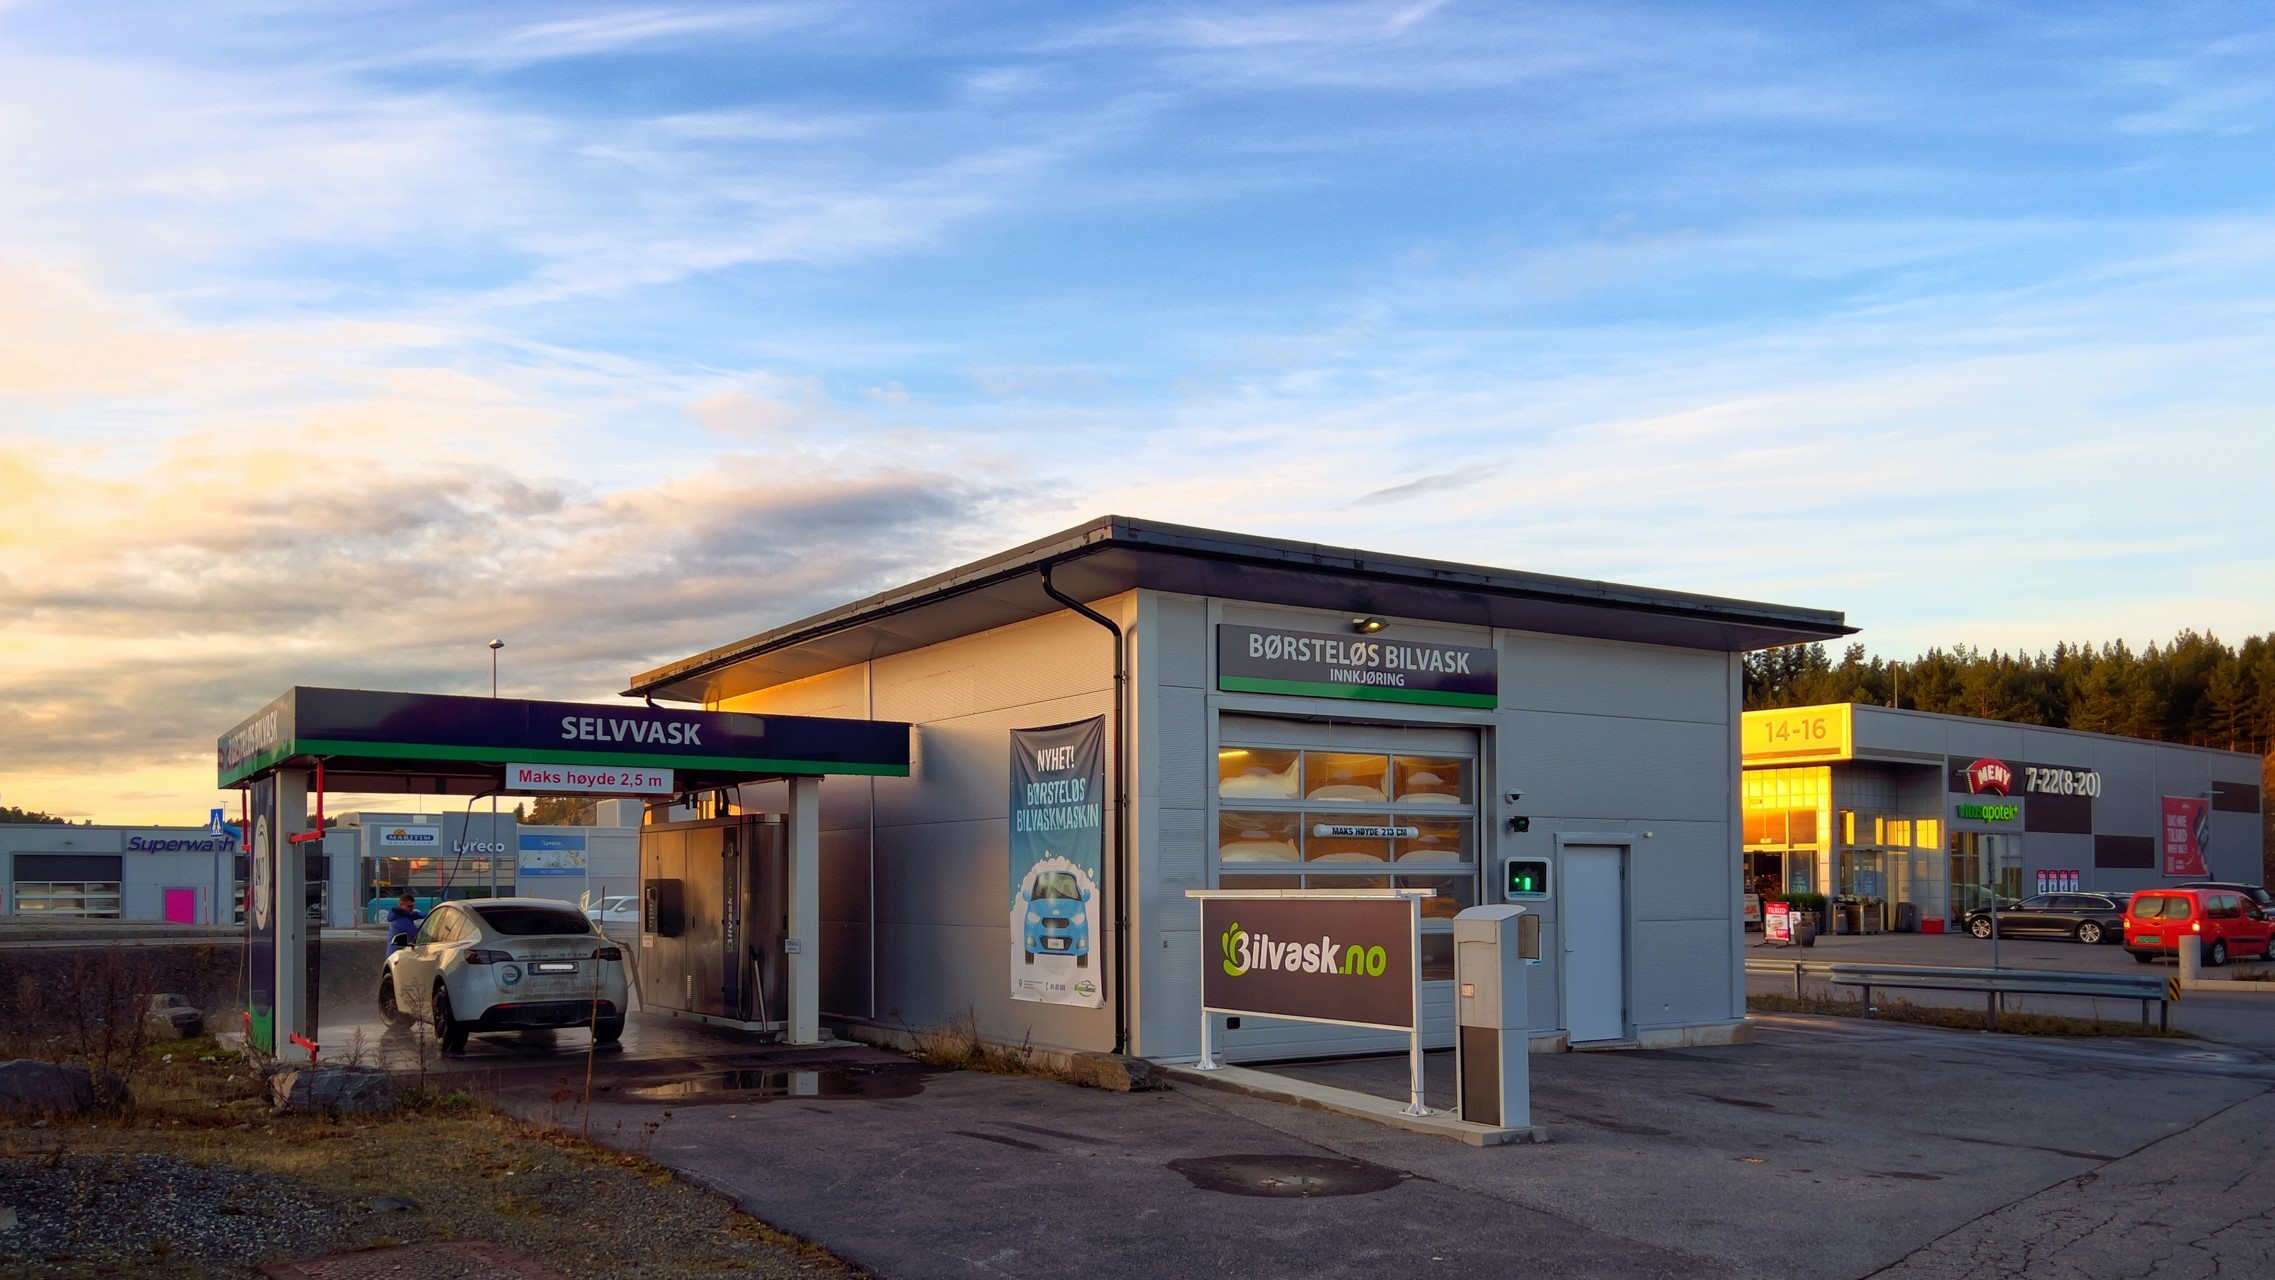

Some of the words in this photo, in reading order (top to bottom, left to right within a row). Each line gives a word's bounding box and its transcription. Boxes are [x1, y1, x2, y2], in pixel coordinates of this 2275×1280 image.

[1250, 633, 1379, 667] BØRSTELØS
[1385, 645, 1470, 675] BILVASK
[1330, 668, 1405, 687] INNKJØRING
[561, 716, 701, 745] SELVVASK
[1765, 717, 1827, 742] 14-16
[1037, 745, 1075, 772] NYHET!
[519, 769, 561, 784] Maks
[567, 771, 616, 788] høyde
[620, 773, 643, 788] 2,5
[649, 776, 662, 786] m
[1977, 764, 2011, 786] MENY
[1027, 778, 1086, 806] BØRSTELØS
[1016, 803, 1099, 832] BILVASKMASKIN
[1332, 827, 1354, 836] MAKS
[1381, 828, 1394, 836] 213
[1396, 828, 1408, 836] CM
[453, 839, 505, 854] Lyreco
[1222, 924, 1388, 977] Bilvask.no
